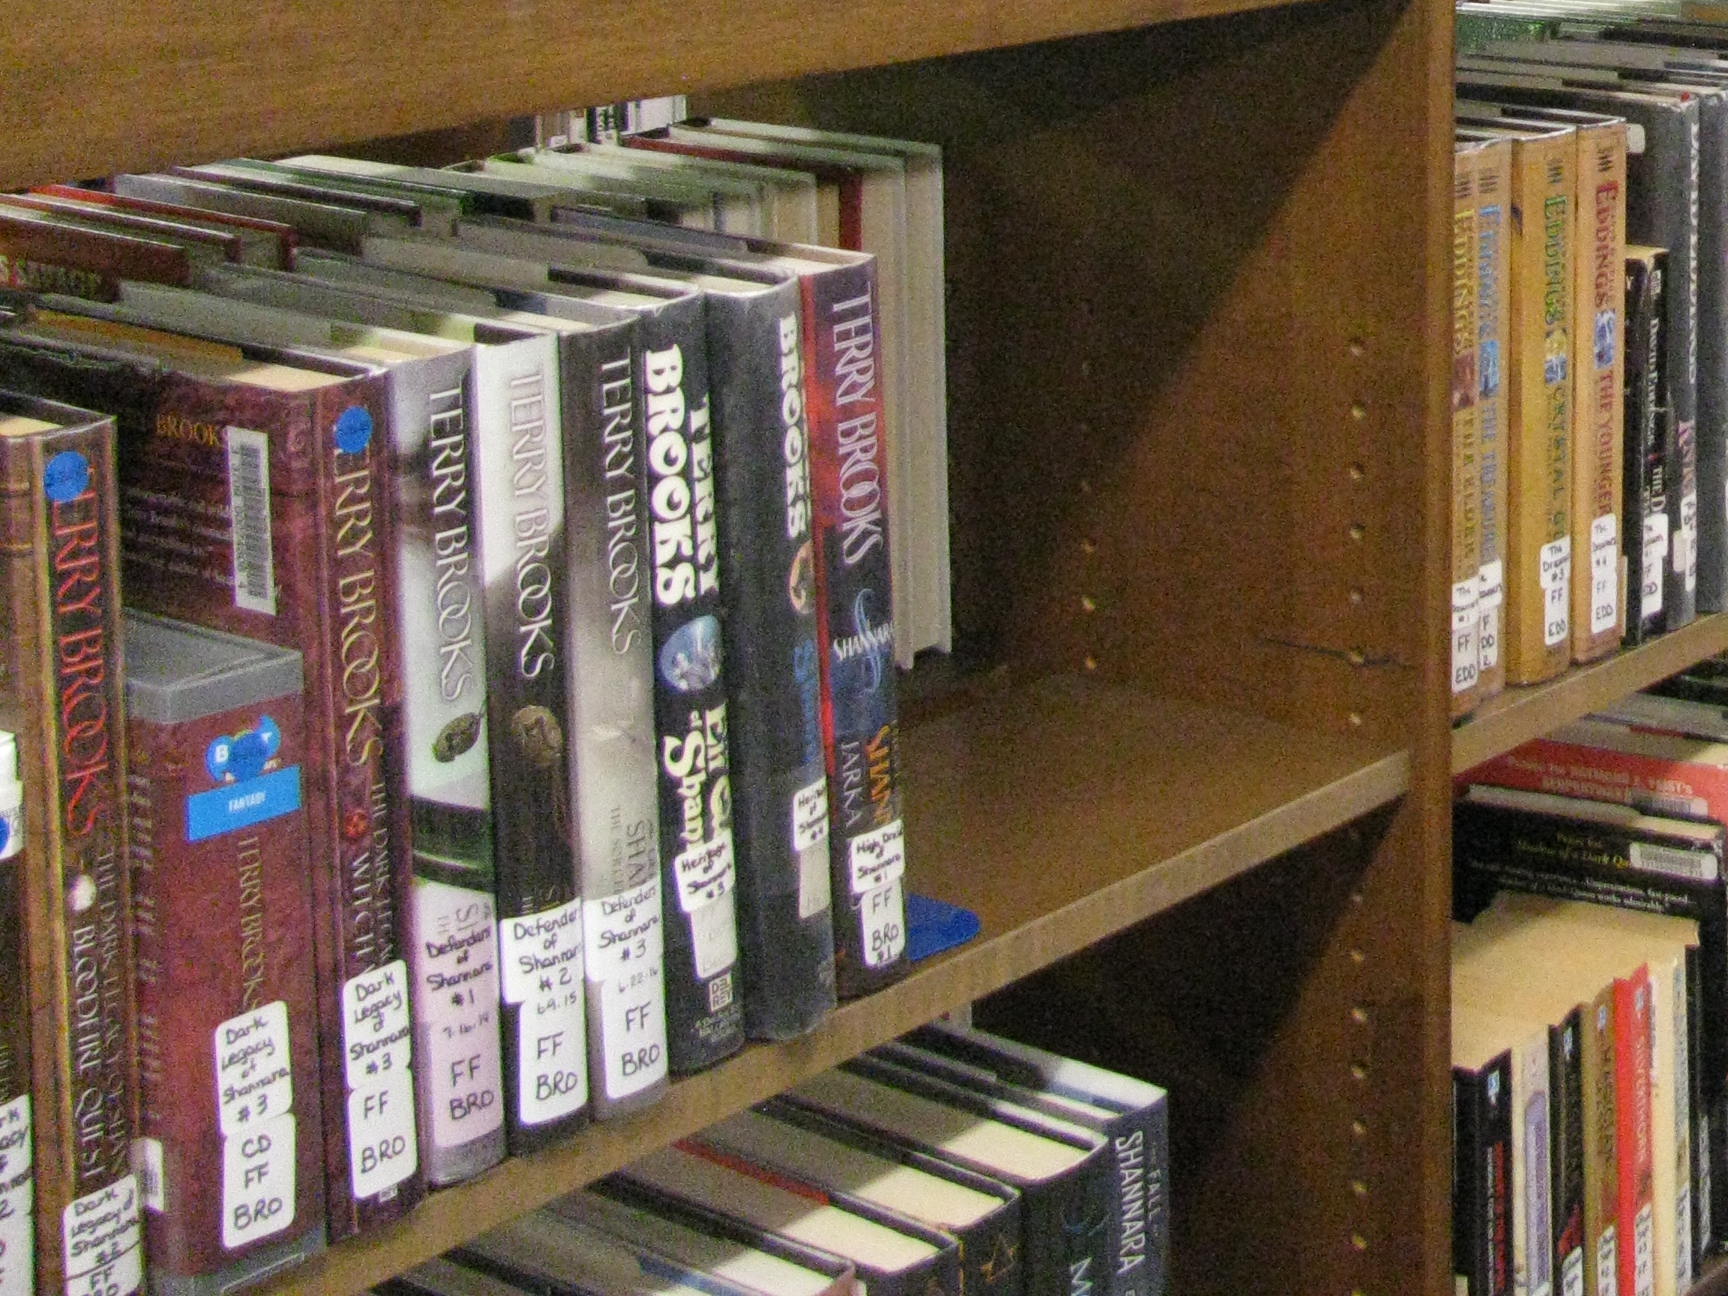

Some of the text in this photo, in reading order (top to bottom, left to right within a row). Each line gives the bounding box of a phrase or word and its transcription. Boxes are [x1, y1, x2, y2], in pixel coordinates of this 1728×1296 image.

[1543, 194, 1568, 326] EDDINGS
[1593, 180, 1620, 310] EDDINGS
[1454, 208, 1476, 356] EDDINGS
[1598, 369, 1615, 416] THE
[779, 312, 811, 540] BROOKS
[832, 280, 884, 565] TERRY BROOKS
[643, 343, 697, 606] BROOKS
[601, 347, 642, 656] TERRY BROOKS
[429, 380, 474, 702] TERRY BROOKS
[510, 374, 555, 680] TERRY BROOKS
[333, 439, 383, 768] ERRY BROOKS
[1550, 587, 1563, 603] FF
[1595, 604, 1614, 621] EDD
[1457, 633, 1472, 653] FF
[1548, 622, 1567, 638] EDD
[52, 466, 109, 837] ERRY BROOKS
[1455, 663, 1476, 684] EDD
[841, 741, 865, 828] JARKA
[855, 839, 881, 857] High
[238, 835, 263, 908] TERRY
[351, 851, 375, 956] WITCH
[871, 887, 894, 913] FF
[542, 932, 559, 951] of
[870, 923, 900, 952] BRO
[354, 973, 395, 1002] Dark
[353, 989, 402, 1024] Legacy
[625, 1002, 653, 1032] FF
[225, 1016, 269, 1046] Dark
[536, 1031, 566, 1061] FF
[72, 923, 106, 1179] BLOODFIRE QUEST
[221, 1034, 277, 1068] Legacy
[621, 1043, 661, 1077] BRO
[449, 1053, 482, 1088] FF
[534, 1070, 580, 1102] BRO
[362, 1090, 389, 1120] FF
[448, 1088, 496, 1121] BRO
[241, 1133, 272, 1161] CD
[359, 1136, 406, 1175] BRO
[244, 1162, 270, 1189] FF
[233, 1198, 284, 1231] BRO
[1115, 1130, 1146, 1275] SHANNARA
